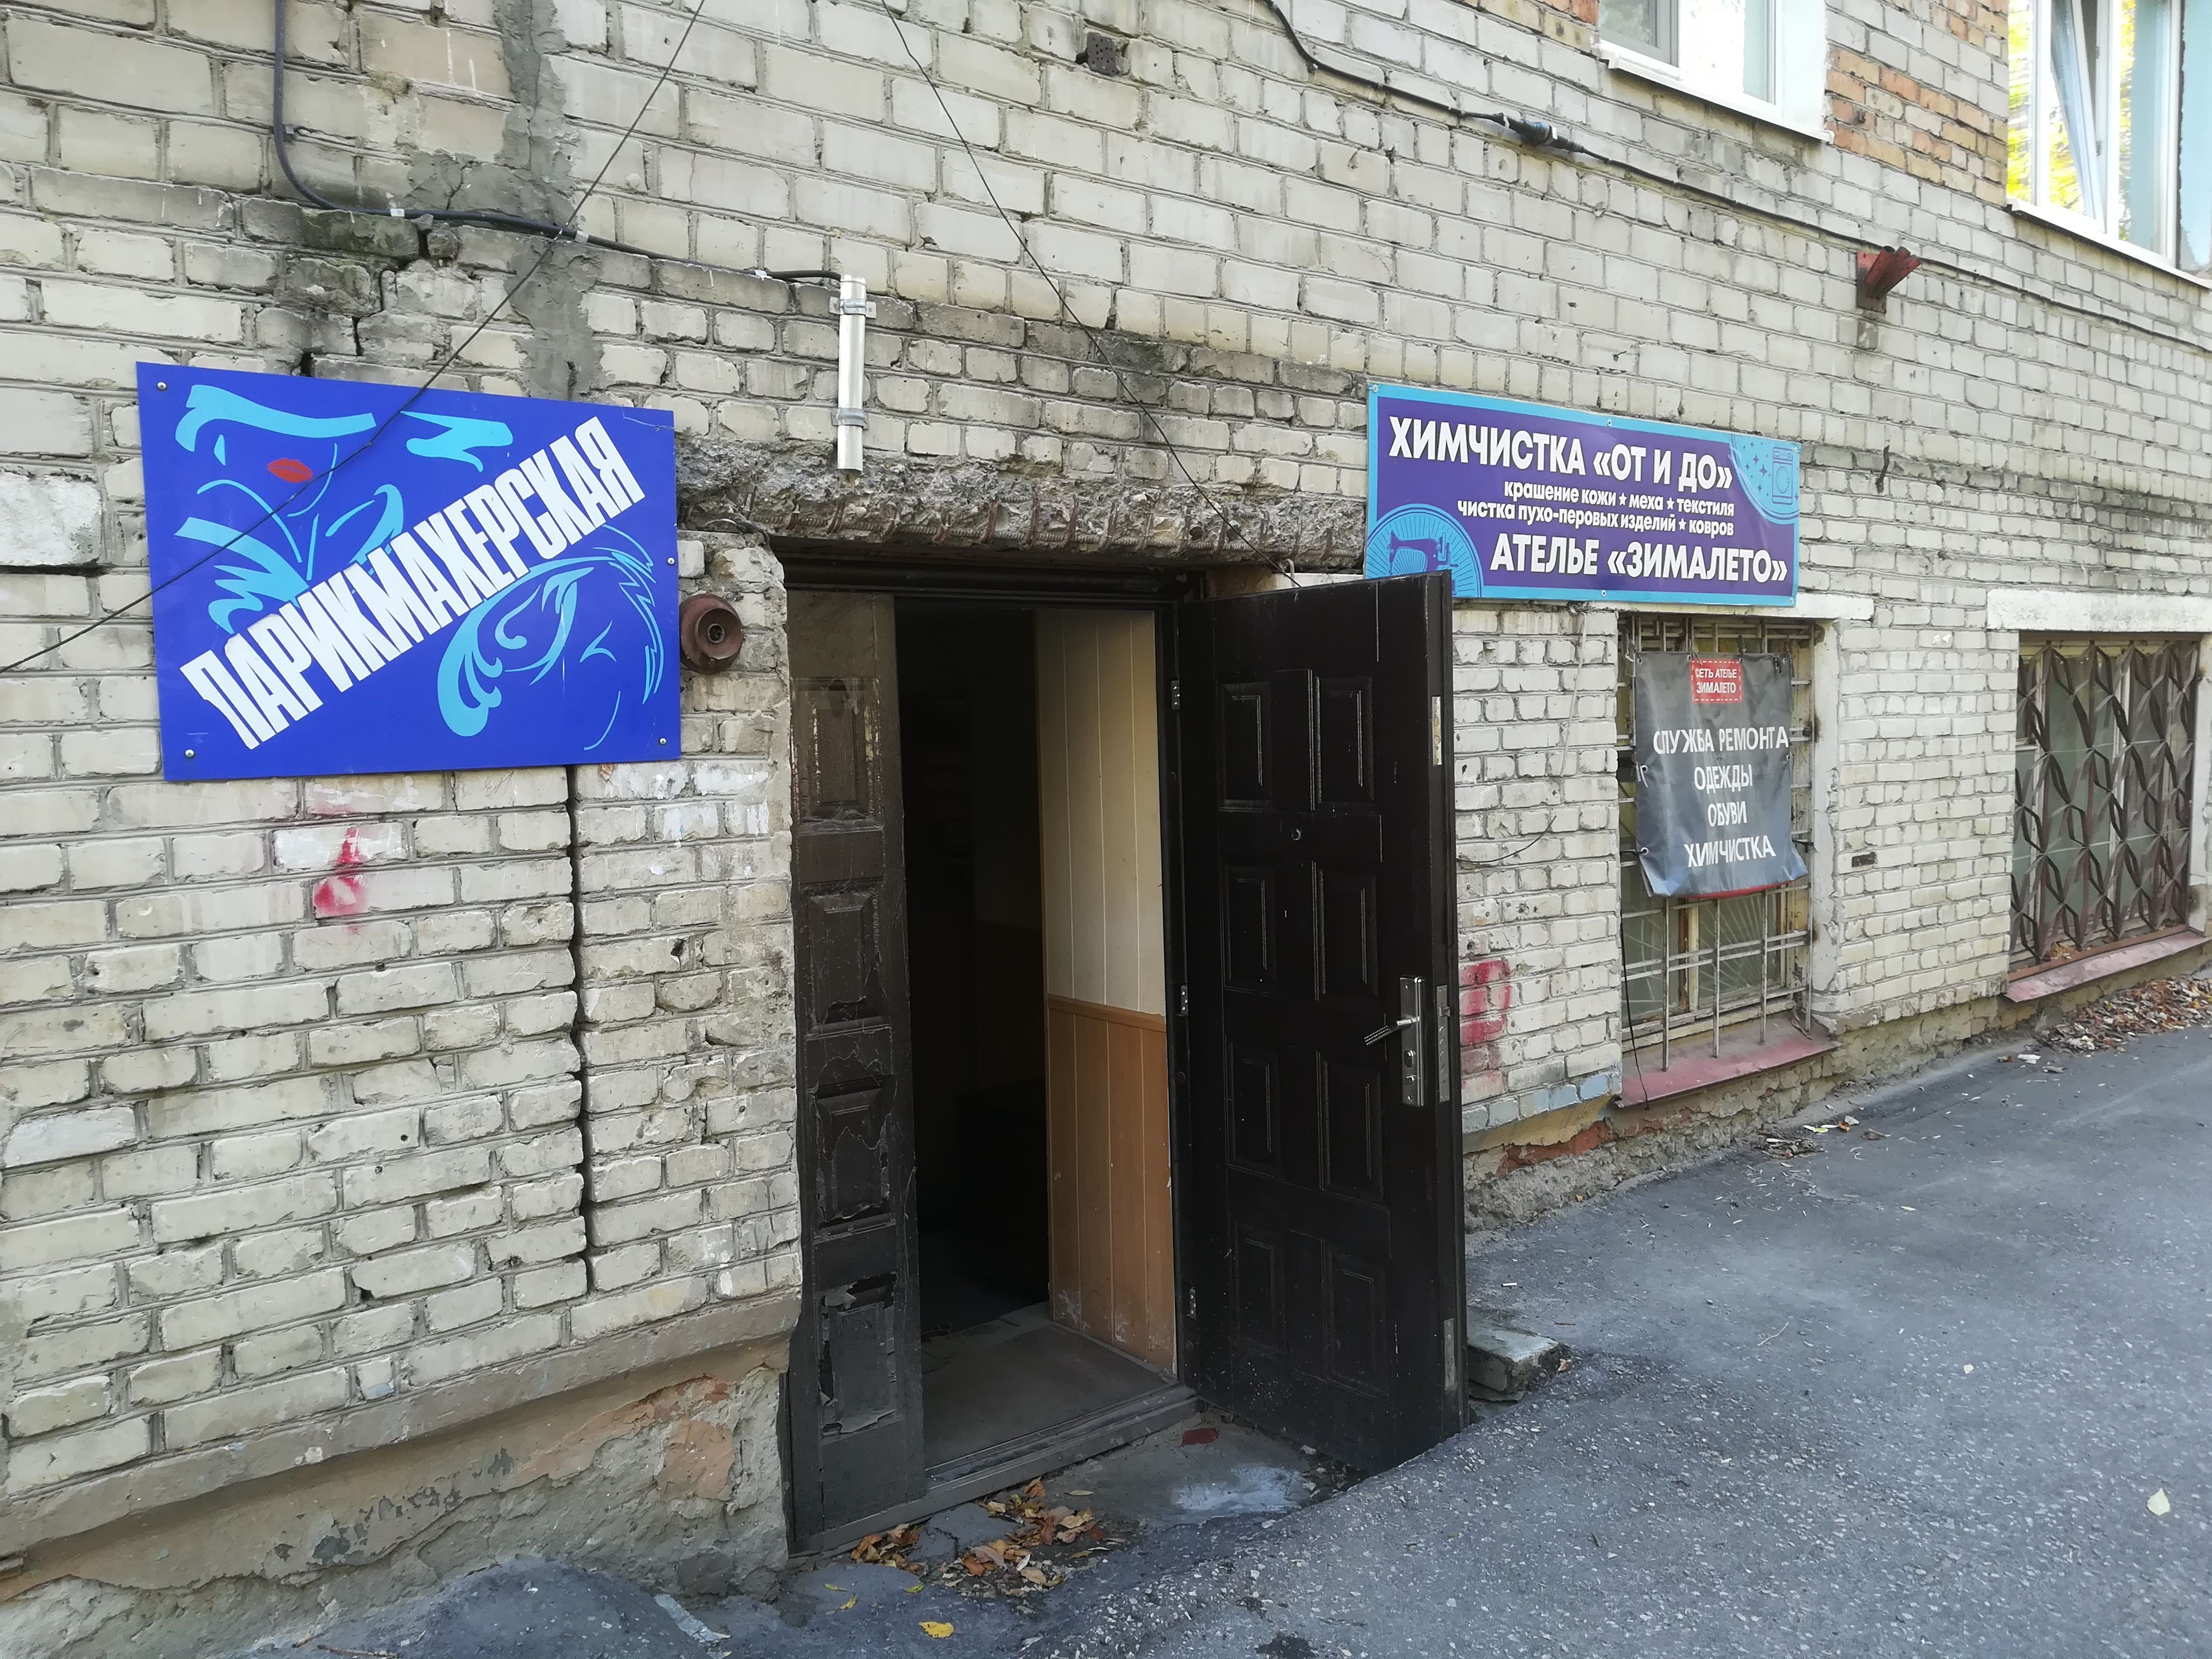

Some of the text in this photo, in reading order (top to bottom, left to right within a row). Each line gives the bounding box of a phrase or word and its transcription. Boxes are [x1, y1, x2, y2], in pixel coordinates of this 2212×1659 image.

[1389, 416, 1733, 494] ХИМЧИСТКА «ОТ И ДО»
[1504, 480, 1734, 517] крашение кожи меха текстиля
[1457, 500, 1734, 538] чистка пухо-перовых изделий ковров
[1490, 533, 1787, 583] АТЕЛЬЕ «ЗИМАЛЕТО»
[180, 416, 645, 750] ПАРИКМАХЕРСКАЯ
[1695, 668, 1714, 678] СЕТЬ
[1696, 682, 1736, 694] ЗИМАЛЕТО
[1653, 726, 1789, 754] СЛУЖБА РЕМОНТА
[1694, 764, 1753, 794] ОДЕЖДЫ
[1707, 801, 1747, 827] ОБУВИ
[1684, 835, 1776, 867] ХИМЧИСТКА
